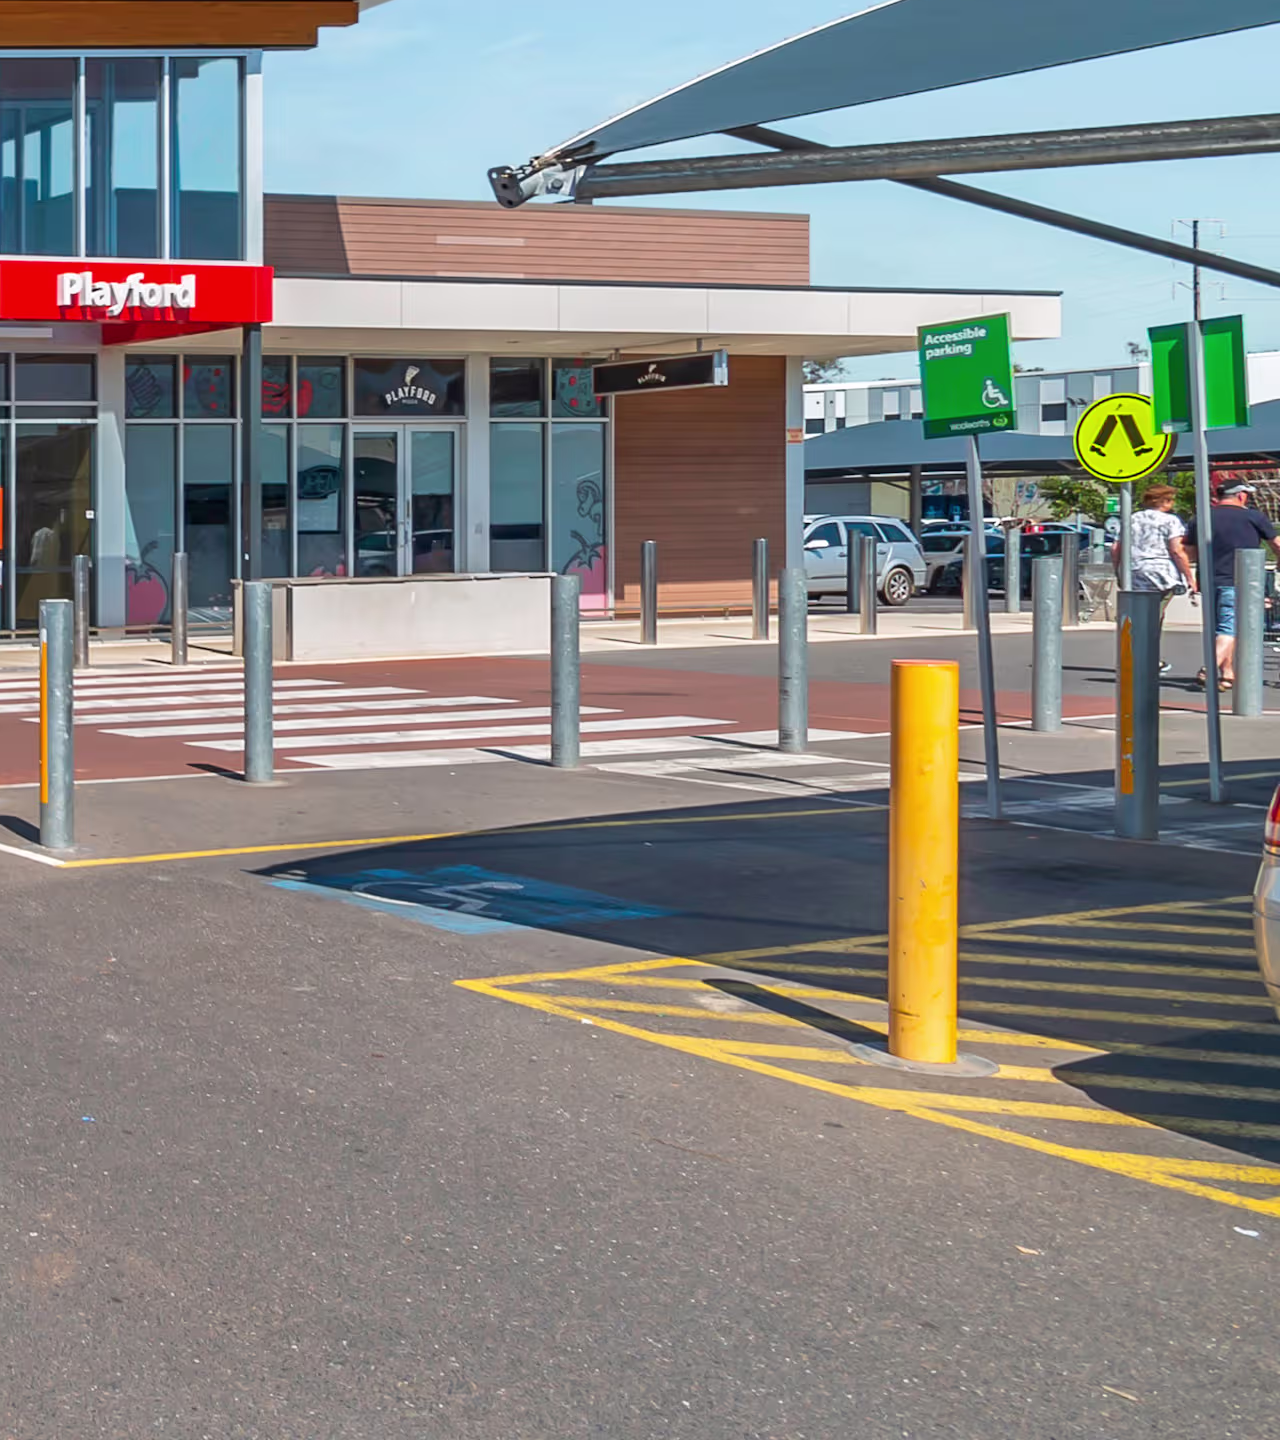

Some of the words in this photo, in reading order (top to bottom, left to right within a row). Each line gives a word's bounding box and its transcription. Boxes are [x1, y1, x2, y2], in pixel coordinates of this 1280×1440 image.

[56, 271, 196, 317] Playford
[924, 326, 987, 346] Accessible
[925, 343, 972, 361] parking
[385, 385, 437, 405] PLAYFORD
